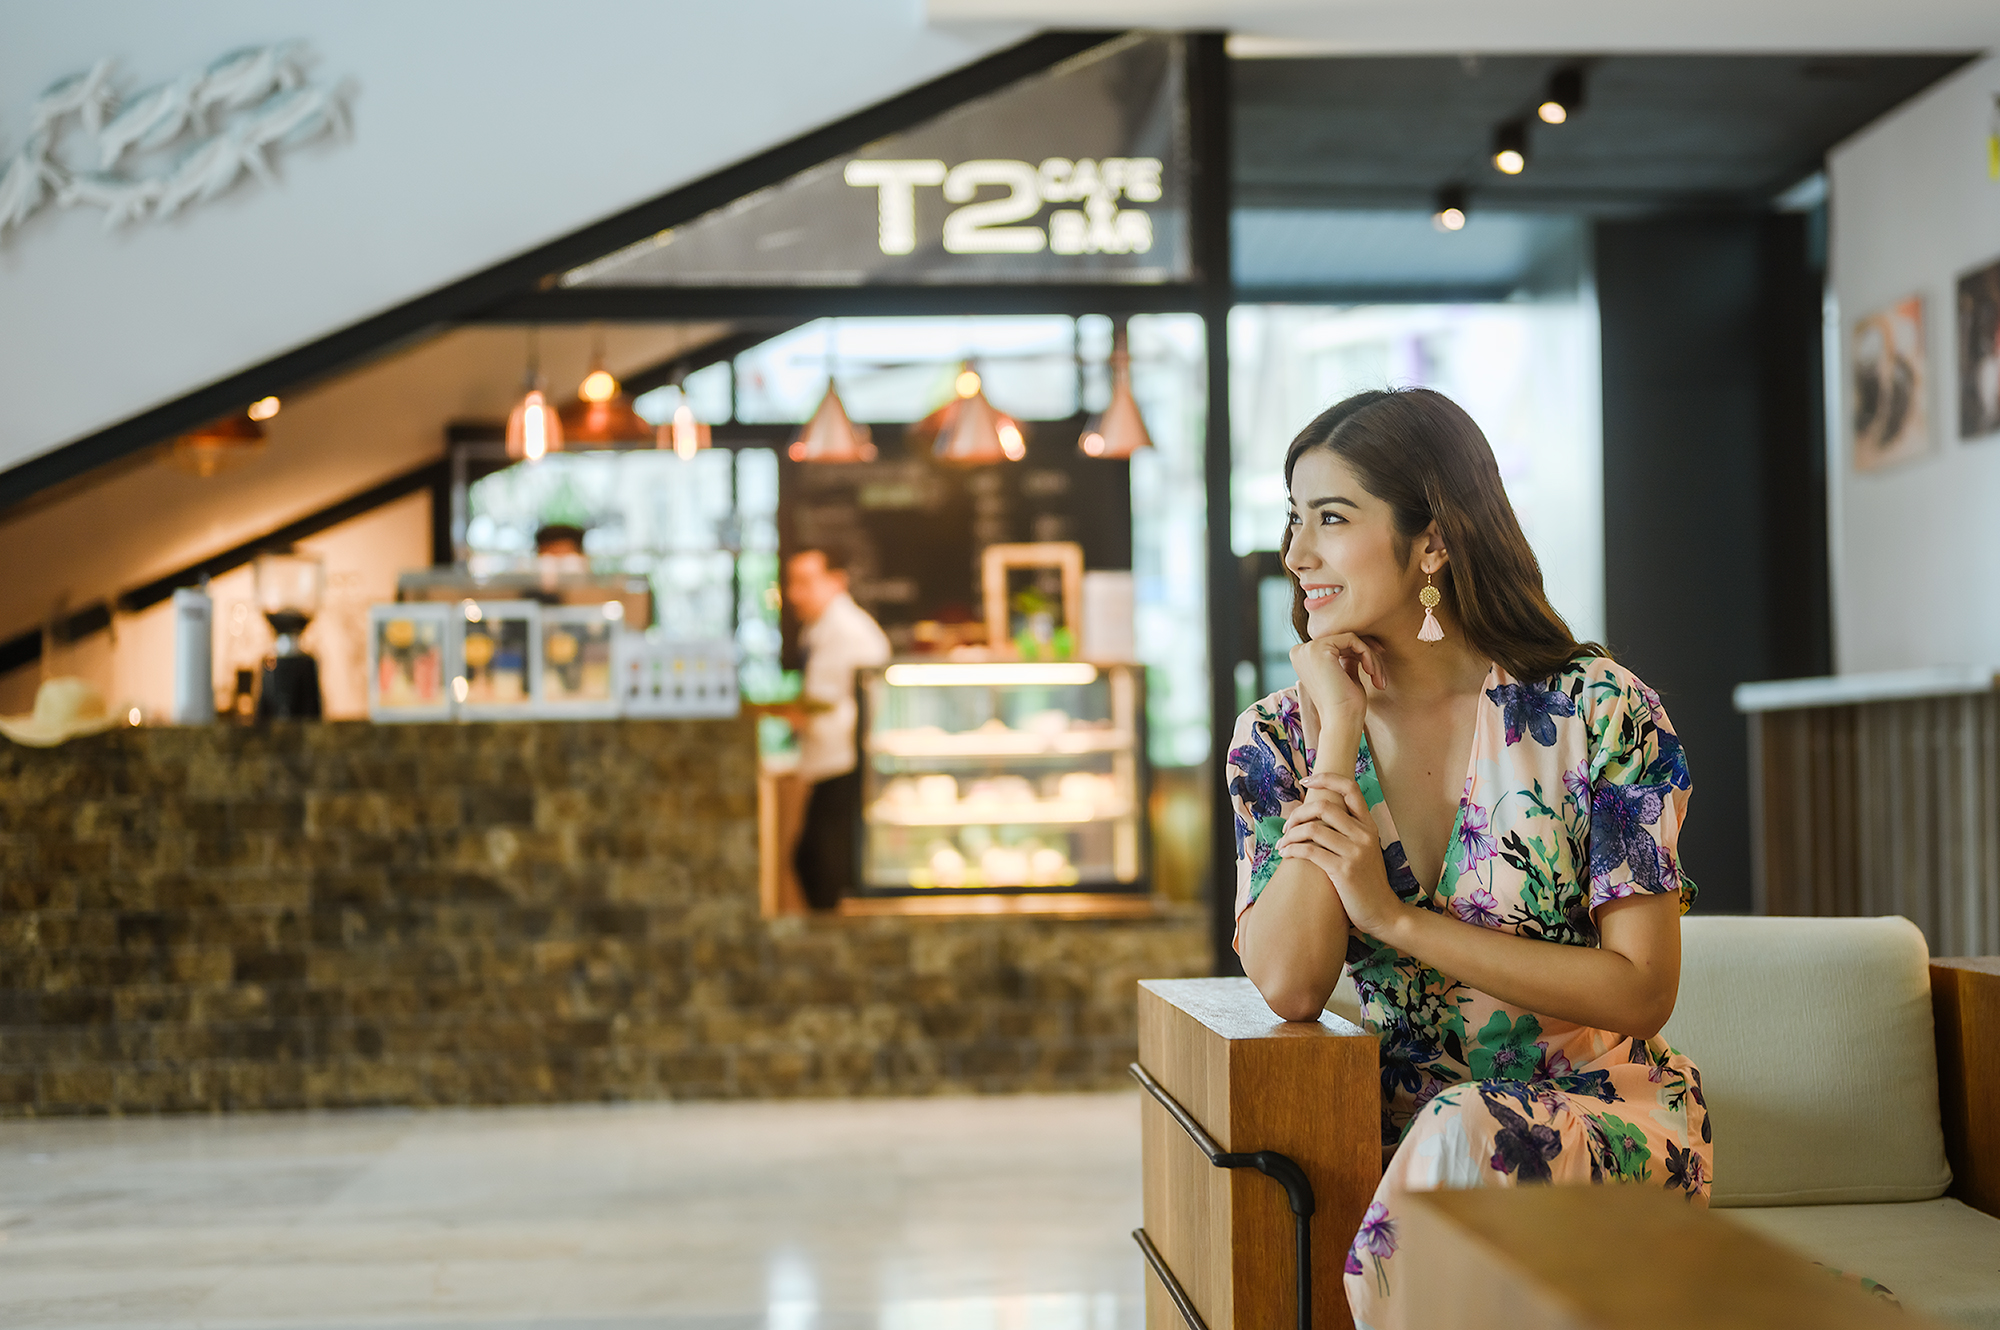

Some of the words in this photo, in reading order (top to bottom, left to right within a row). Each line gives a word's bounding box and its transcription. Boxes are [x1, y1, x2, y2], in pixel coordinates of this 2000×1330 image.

[1039, 157, 1163, 203] CAFE
[843, 159, 1047, 255] T2
[1049, 209, 1154, 254] BAR
